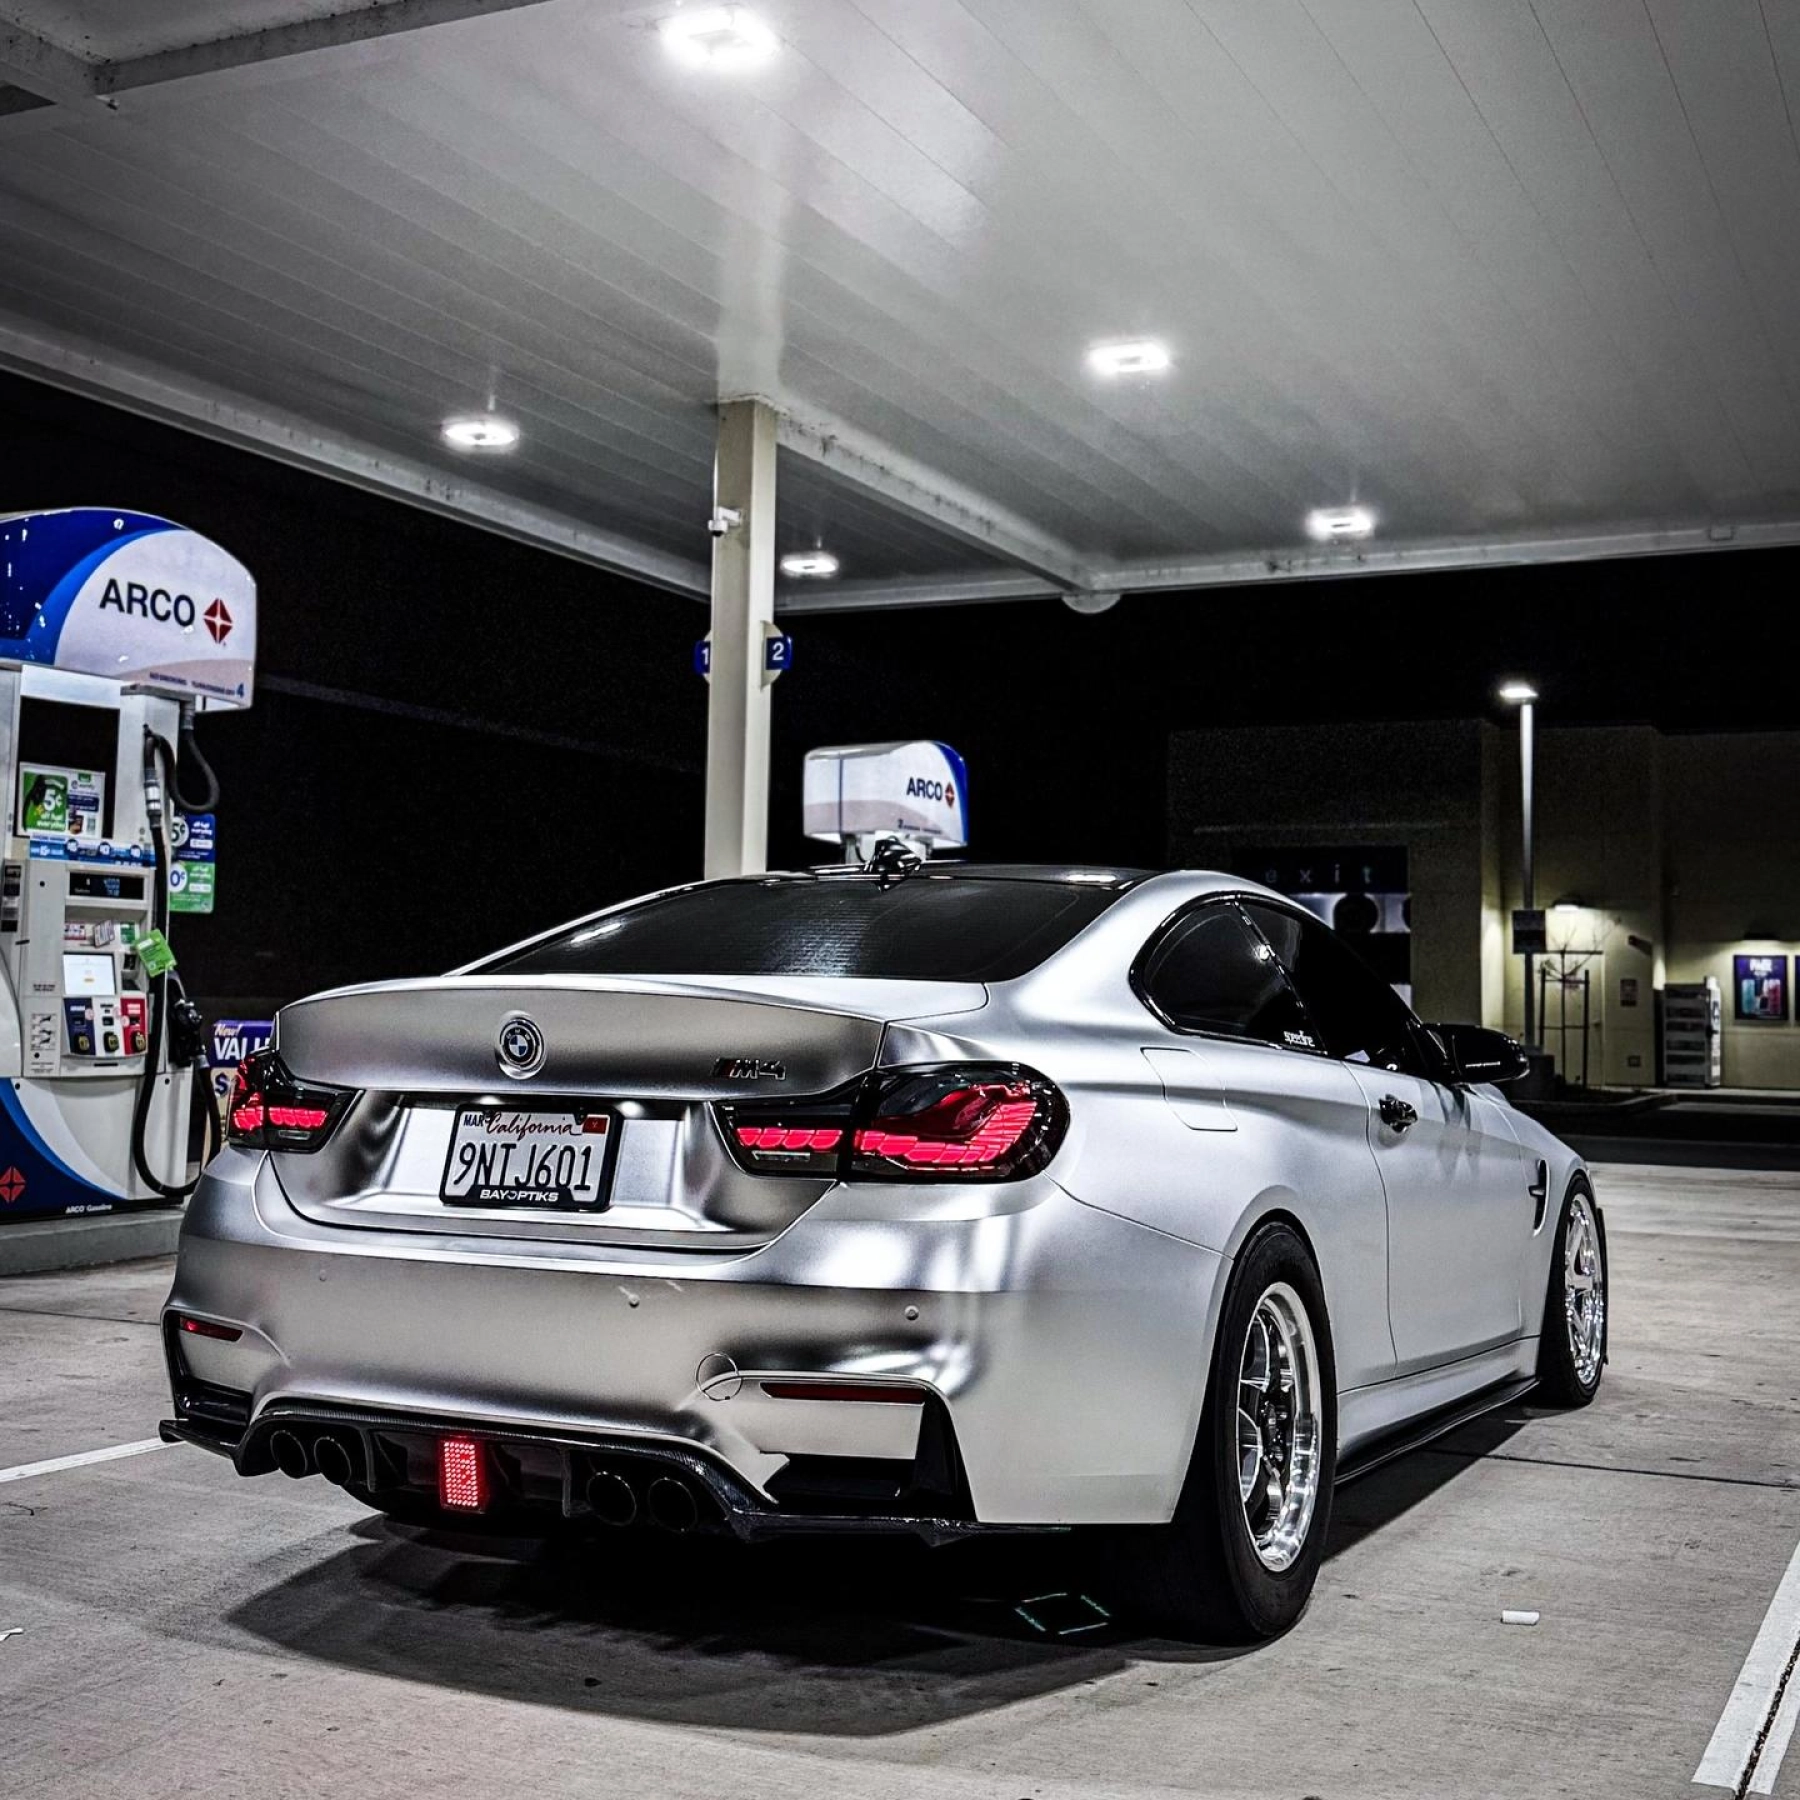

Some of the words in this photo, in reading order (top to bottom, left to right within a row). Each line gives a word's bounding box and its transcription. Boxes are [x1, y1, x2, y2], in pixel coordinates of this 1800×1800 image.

[99, 578, 195, 627] ARCO
[702, 647, 709, 665] 1
[772, 642, 784, 660] 2
[236, 683, 244, 698] 4
[906, 776, 943, 801] ARCO
[463, 1114, 484, 1127] MAR
[485, 1109, 583, 1141] California
[453, 1142, 593, 1191] 9NTJ601
[65, 1205, 85, 1214] ARCO
